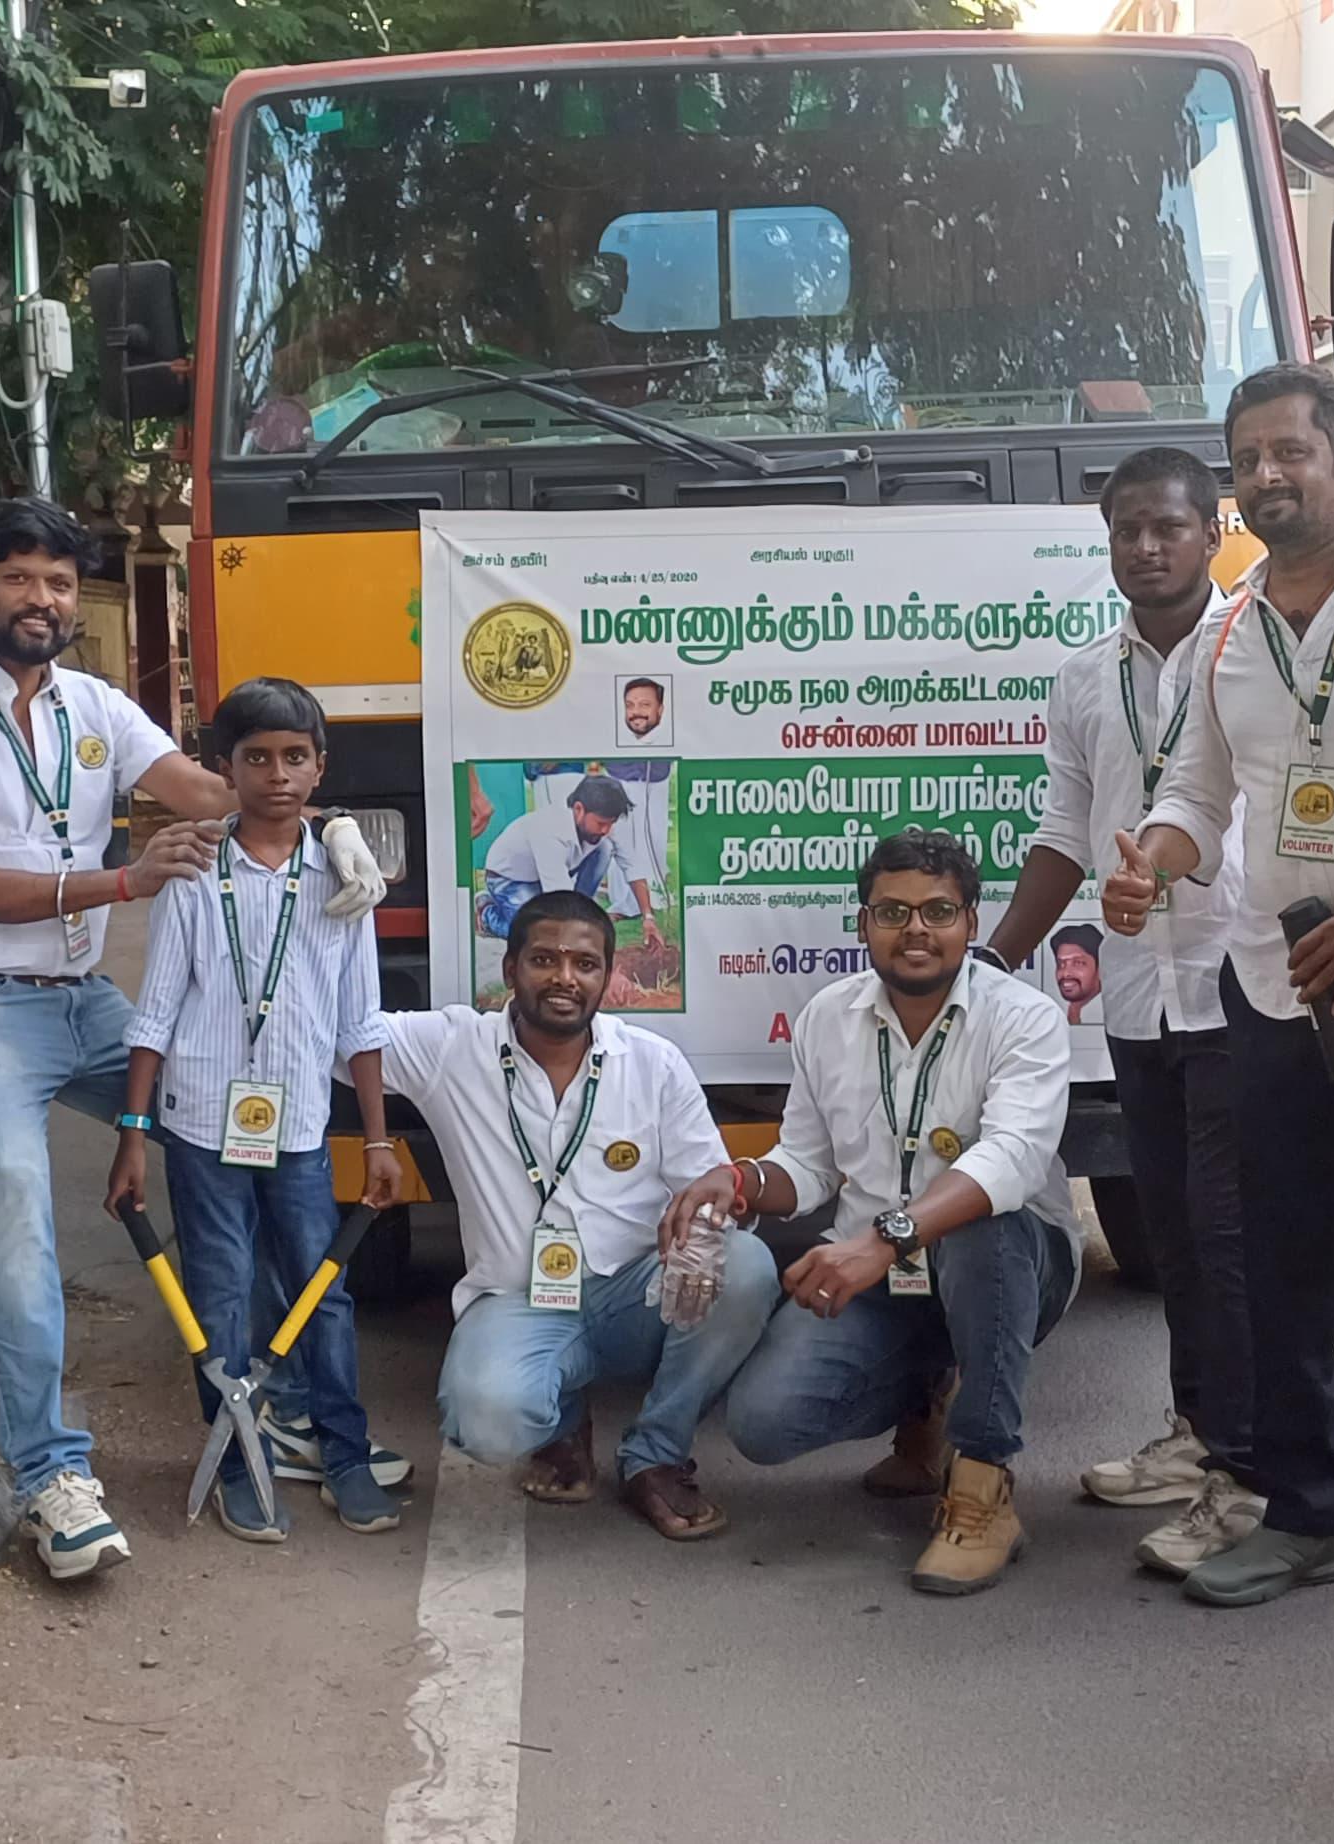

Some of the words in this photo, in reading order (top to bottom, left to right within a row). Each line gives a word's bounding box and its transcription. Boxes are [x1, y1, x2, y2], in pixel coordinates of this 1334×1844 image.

[750, 547, 807, 563] அரசியல்
[1033, 544, 1082, 558] அன்பே
[581, 591, 854, 665] மண்ணுக்கும்
[864, 589, 1126, 651] மக்களுக்கும்
[708, 679, 792, 715] சமூக
[799, 678, 849, 713] நல
[856, 669, 1055, 712] அறக்கட்டளை
[781, 715, 918, 748] சென்னை
[926, 714, 1047, 747] மாவட்டம்
[688, 764, 901, 821] சாலையோர
[1282, 839, 1334, 854] VOLUNTEER
[226, 1148, 273, 1161] VOLUNTEER
[533, 1295, 577, 1305] VOLUNTEER
